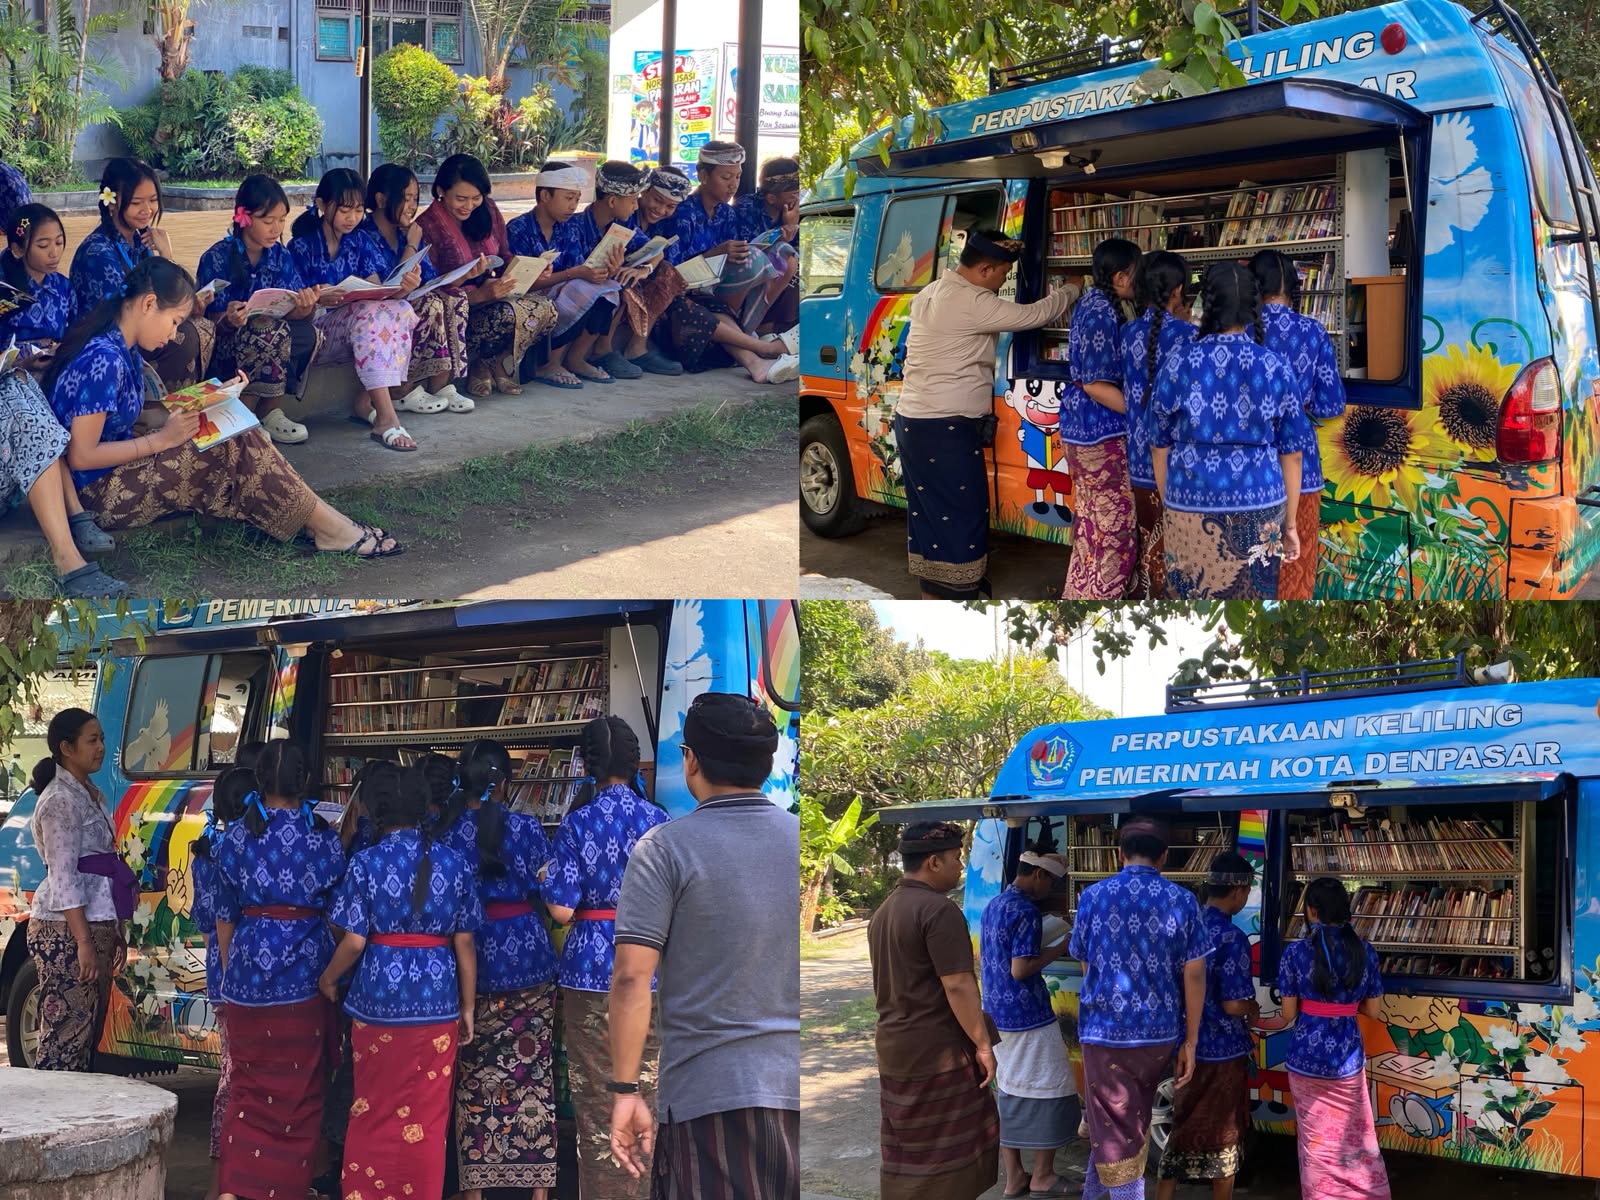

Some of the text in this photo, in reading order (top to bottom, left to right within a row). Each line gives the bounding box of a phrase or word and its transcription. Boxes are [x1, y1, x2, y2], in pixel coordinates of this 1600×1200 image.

[646, 56, 684, 80] STP
[970, 81, 1172, 134] PERPUSTAKA
[1111, 703, 1524, 753] PERPUSTAKAAN KELILING
[1078, 740, 1562, 787] PEMERINTAH KOTA DENPASAR
